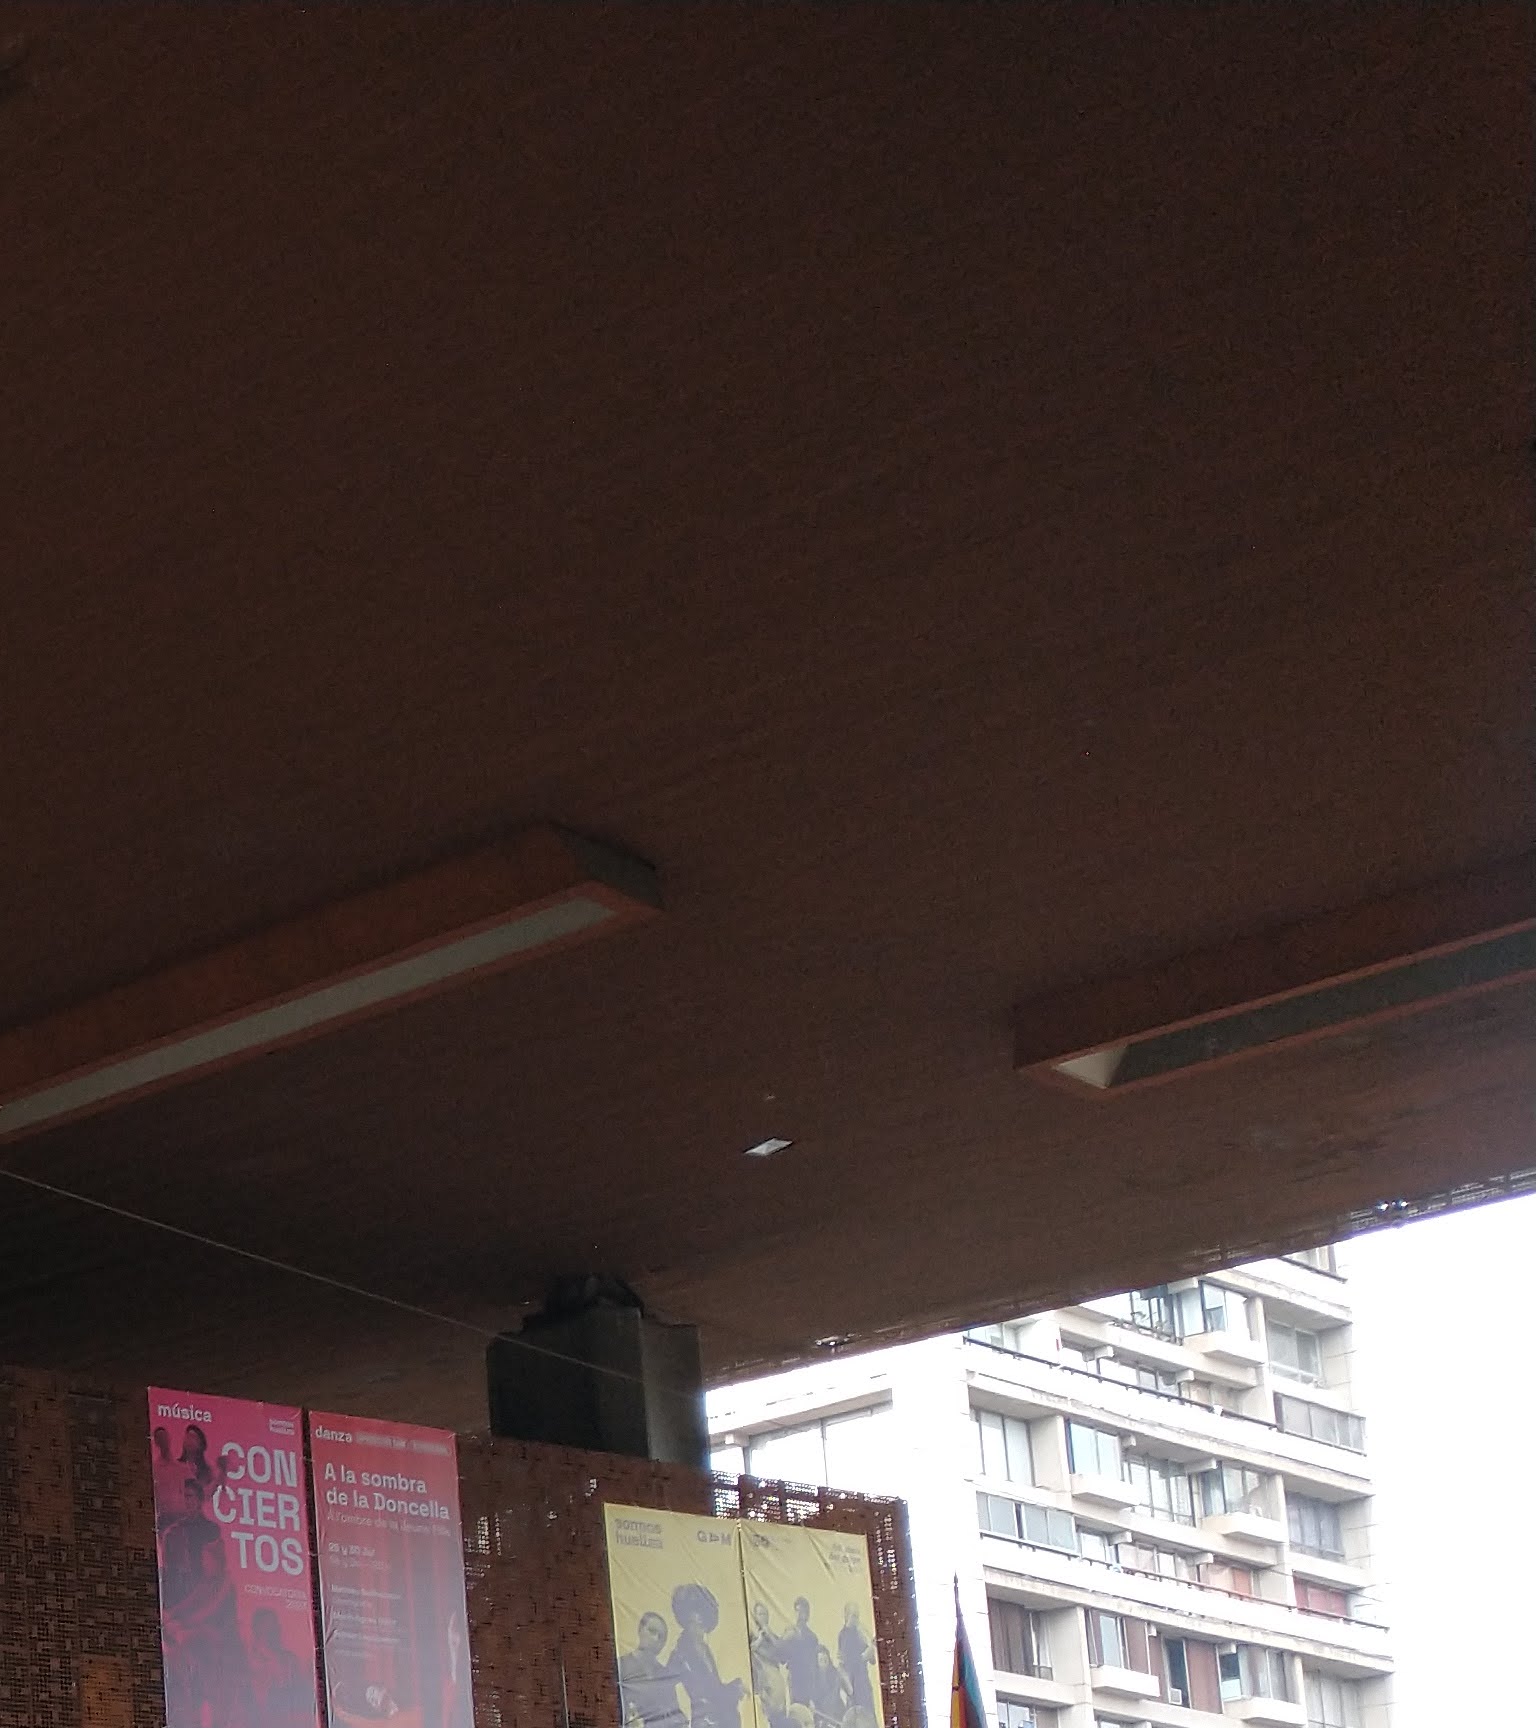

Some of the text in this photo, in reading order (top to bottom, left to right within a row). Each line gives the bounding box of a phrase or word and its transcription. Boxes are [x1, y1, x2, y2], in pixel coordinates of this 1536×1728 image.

[158, 1404, 212, 1422] música
[316, 1425, 352, 1443] danza
[222, 1442, 297, 1488] CON
[324, 1463, 427, 1494] A la sombra
[213, 1485, 300, 1532] CIER
[326, 1487, 450, 1520] de la Doncella
[231, 1531, 304, 1576] TOS
